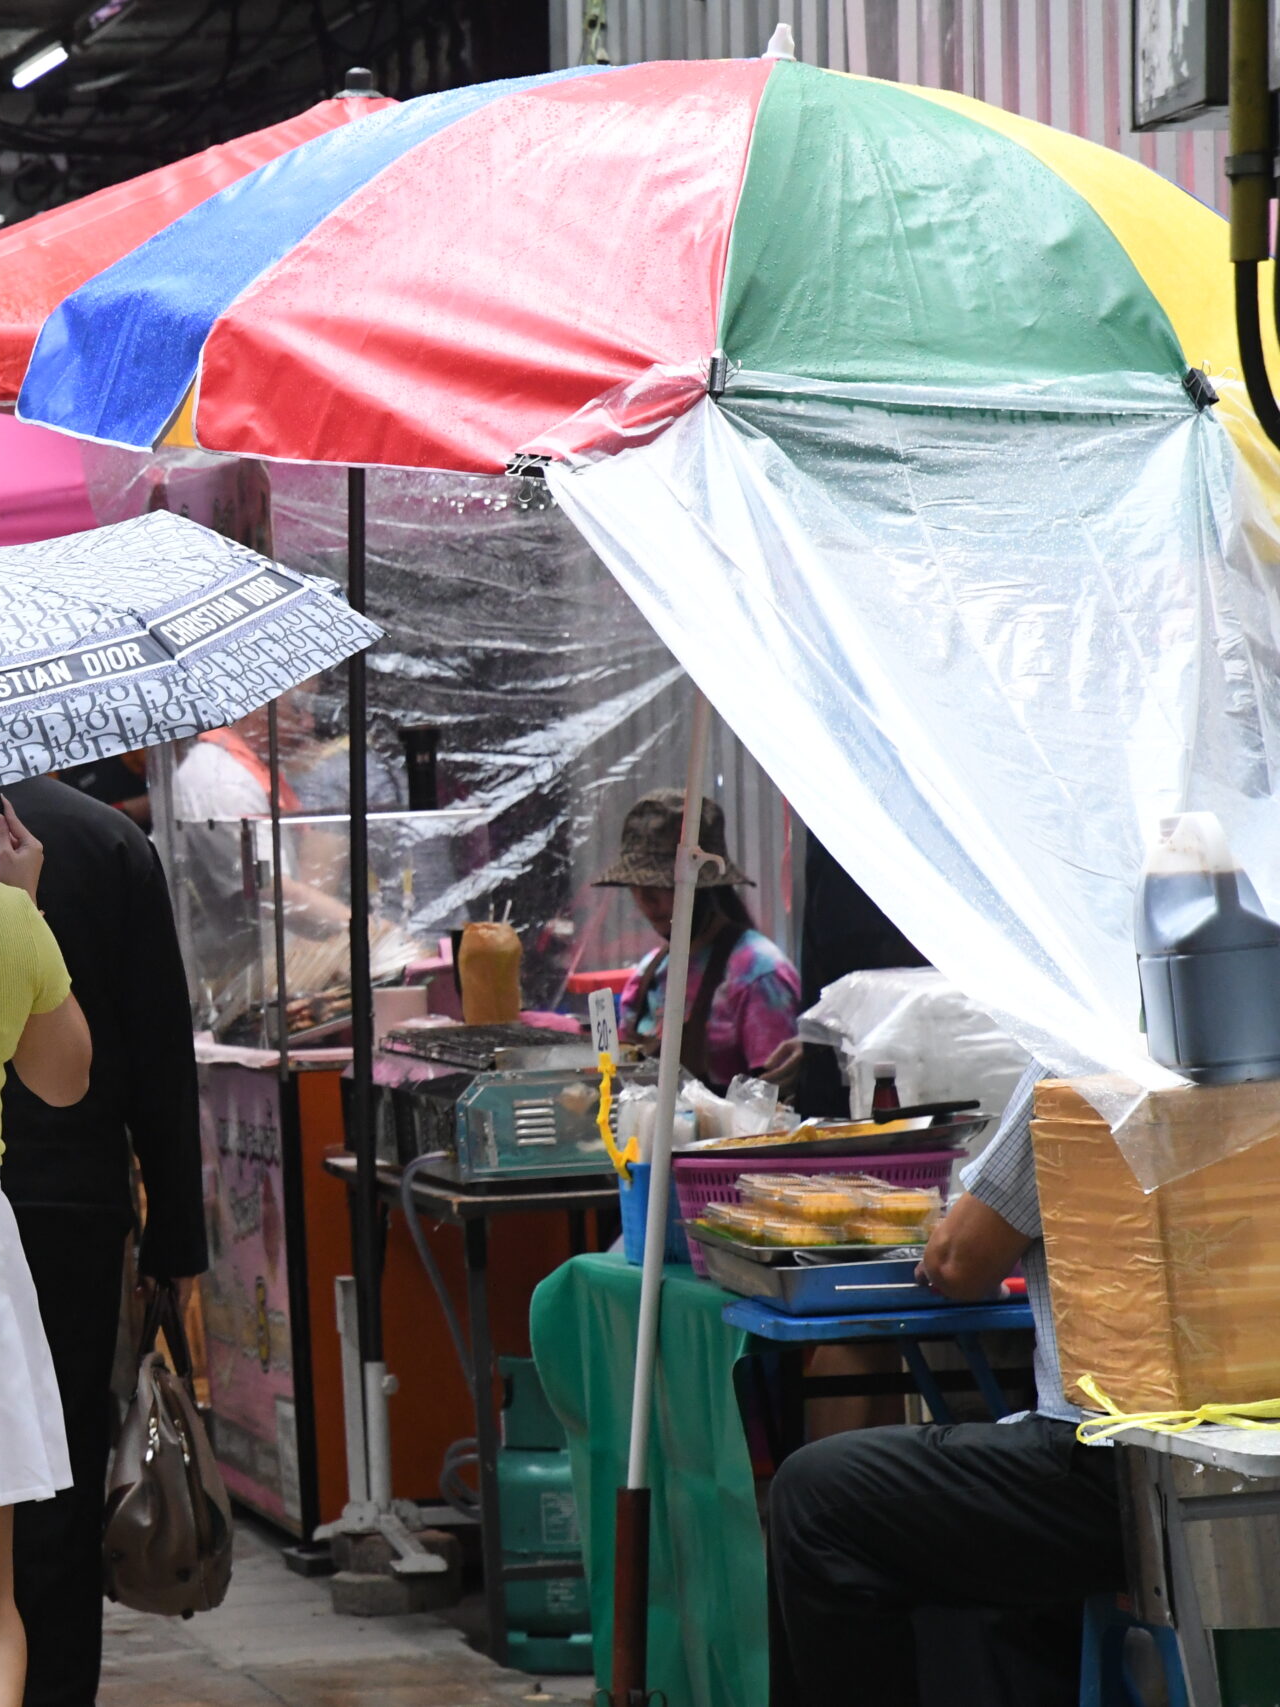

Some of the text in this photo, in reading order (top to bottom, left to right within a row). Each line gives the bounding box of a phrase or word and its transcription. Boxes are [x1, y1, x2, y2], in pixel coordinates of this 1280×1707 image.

[160, 575, 286, 646] CHRISTIAN DIOR
[82, 642, 146, 677] DIOR
